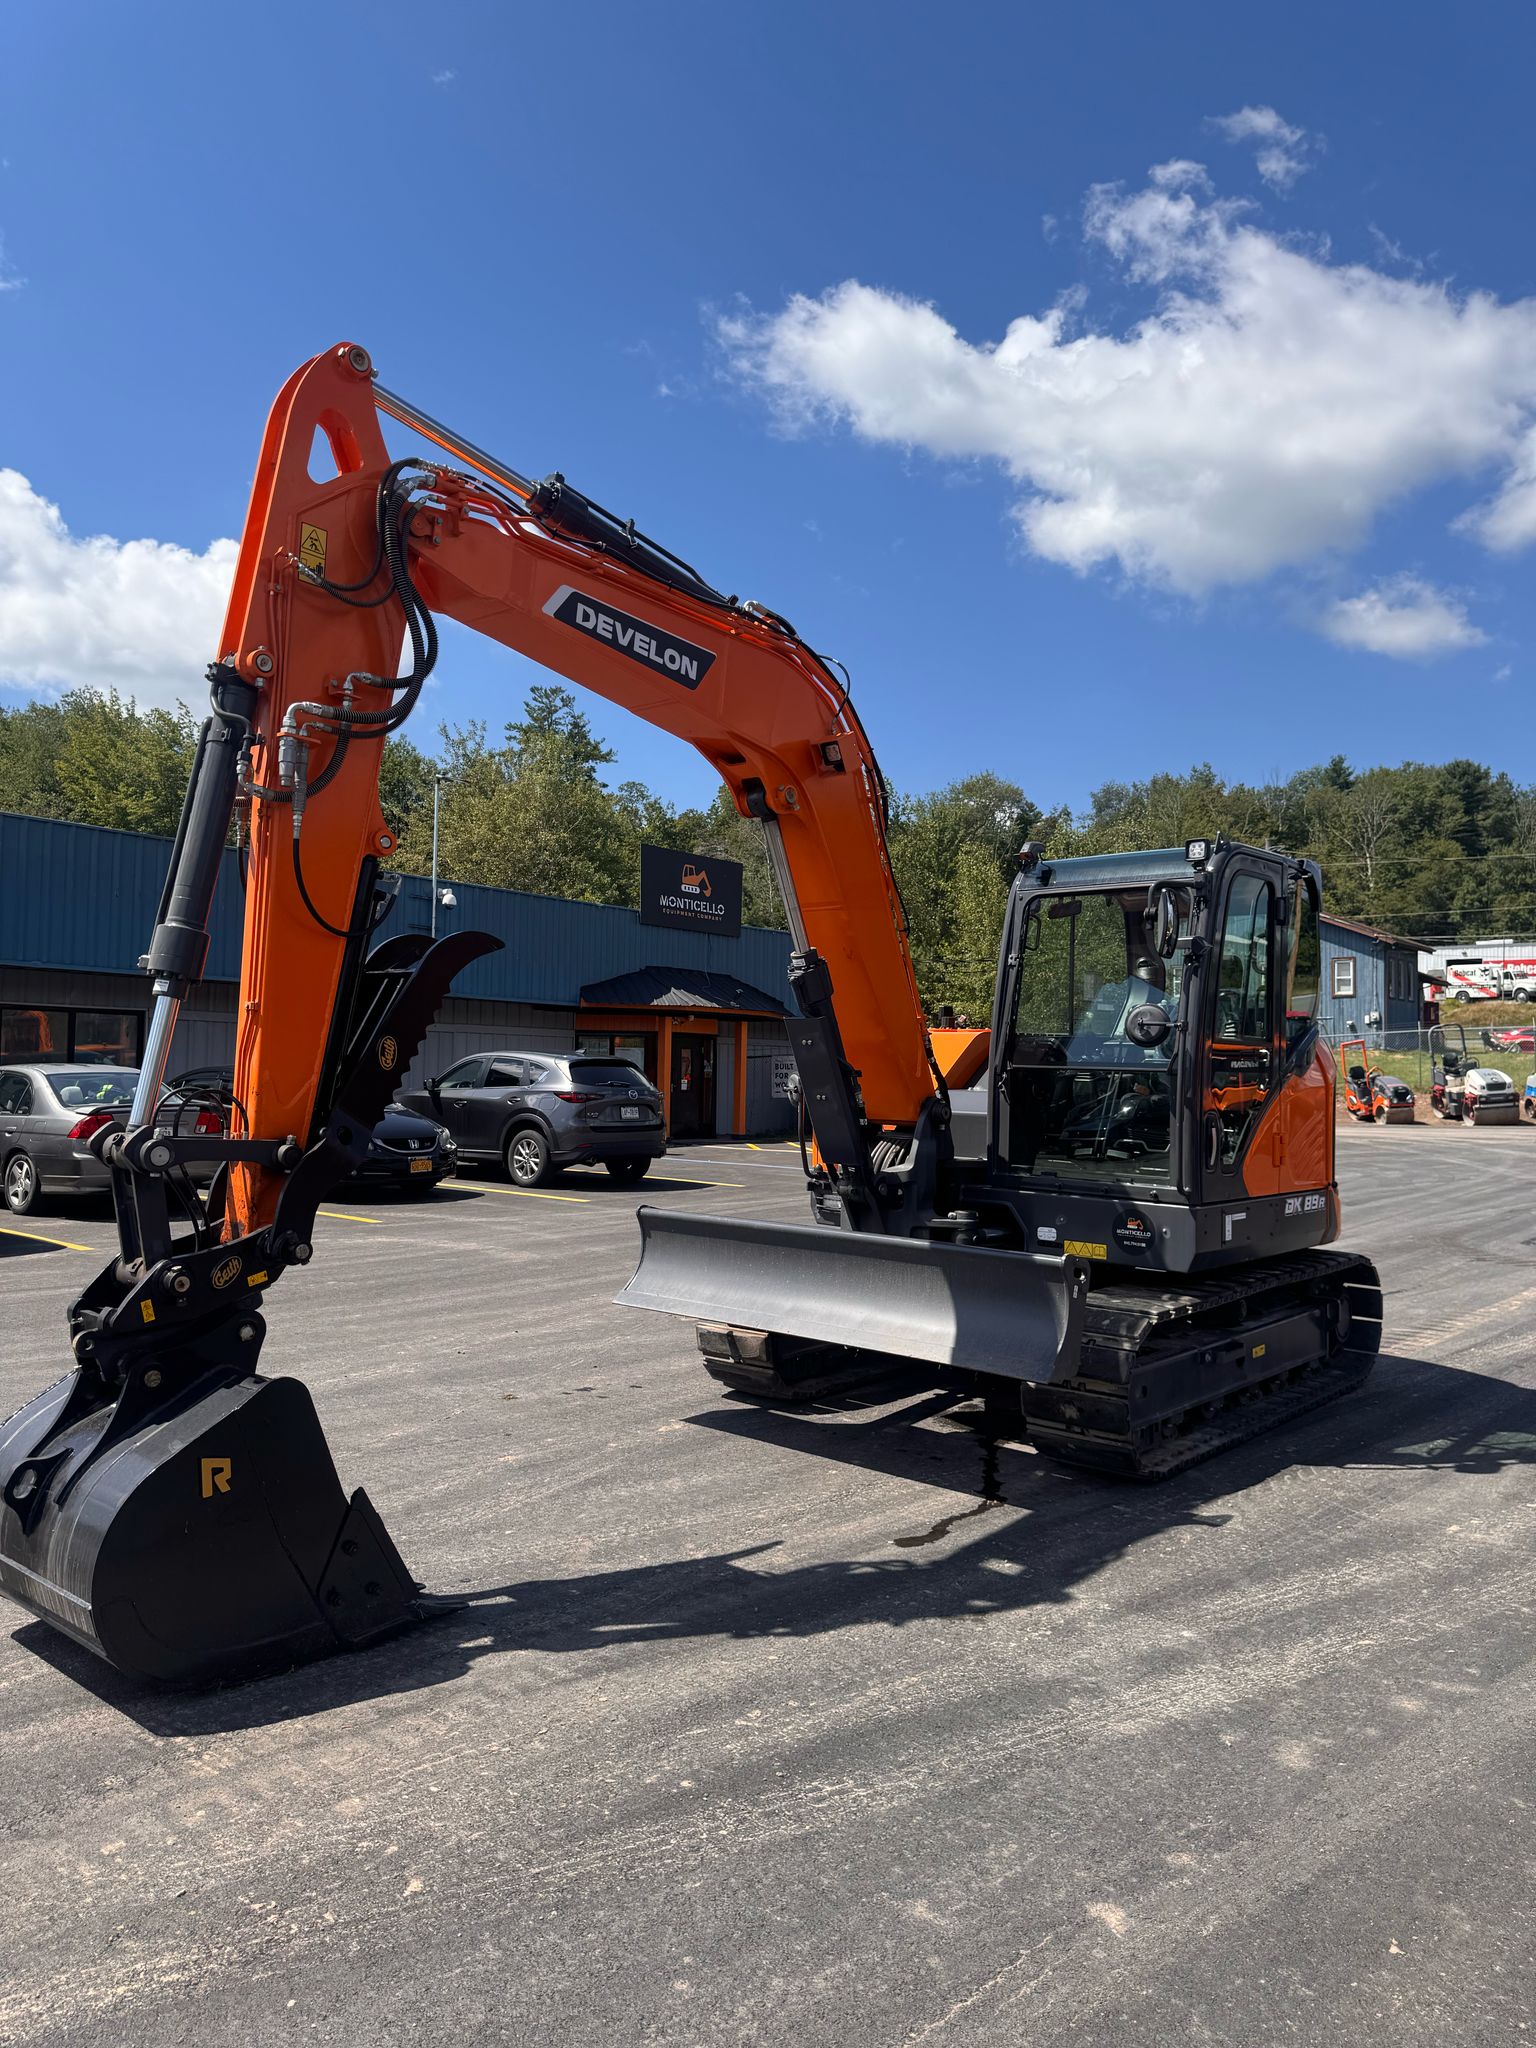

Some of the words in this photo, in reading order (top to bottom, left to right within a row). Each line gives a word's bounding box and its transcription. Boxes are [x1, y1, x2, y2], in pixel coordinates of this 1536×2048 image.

[575, 602, 698, 681] DEVELON
[660, 895, 724, 915] MONTICELLO
[663, 908, 694, 917] EQUIPMENT
[697, 913, 722, 921] COMPANY
[1454, 969, 1476, 977] Bobcat
[1507, 963, 1536, 975] Bobca
[1116, 1228, 1152, 1238] MONTICELLO
[201, 1457, 232, 1498] R
